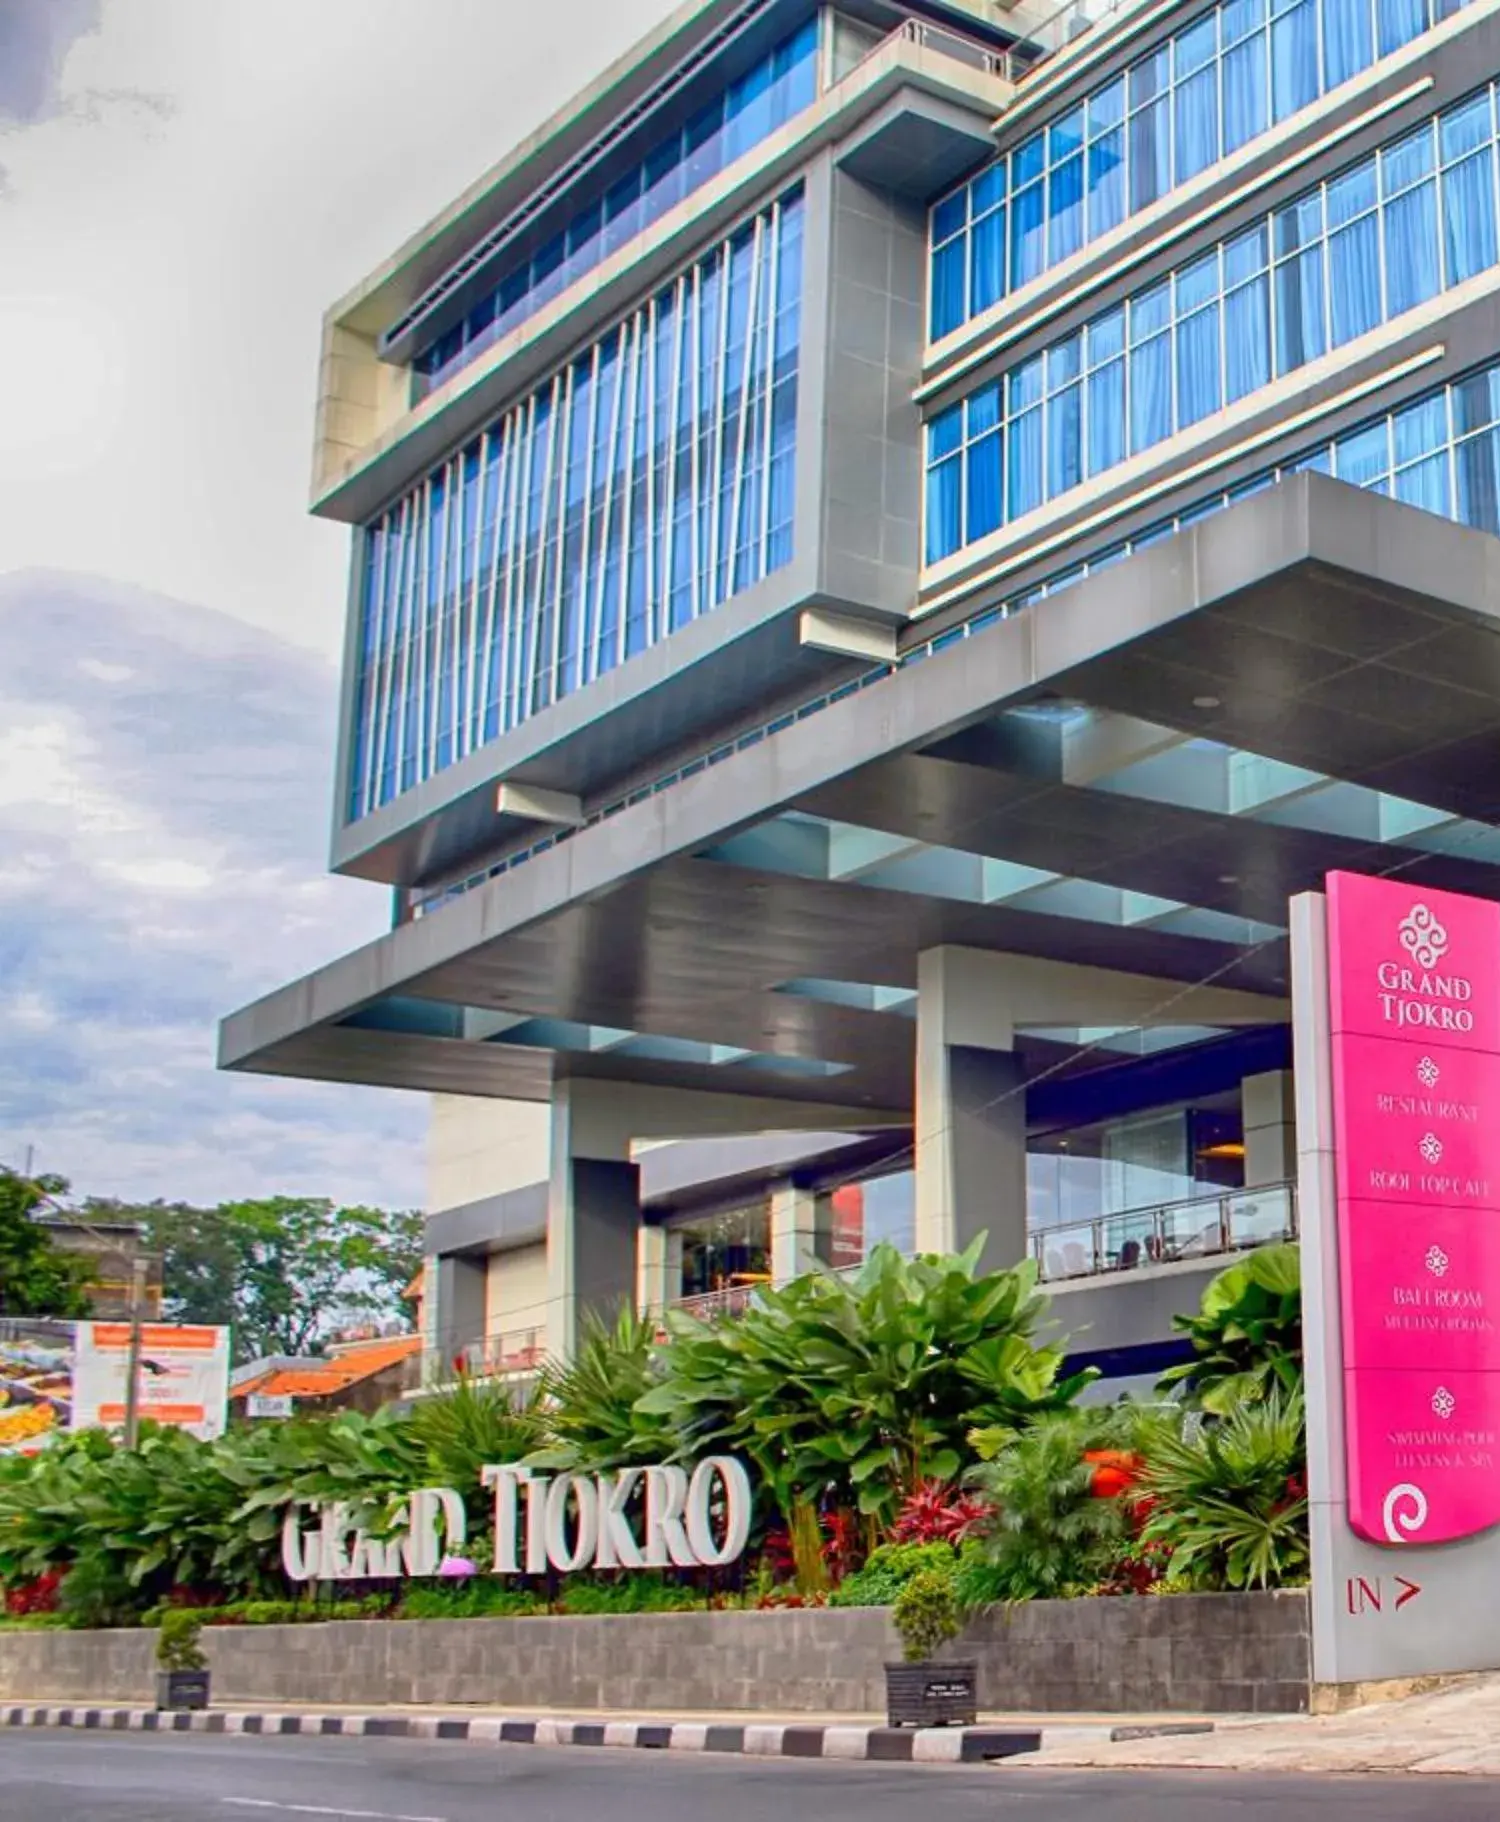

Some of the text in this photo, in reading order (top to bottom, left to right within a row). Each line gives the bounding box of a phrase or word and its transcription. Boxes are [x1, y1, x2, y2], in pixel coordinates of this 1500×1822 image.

[1377, 961, 1472, 1001] GRAND
[1377, 992, 1474, 1032] TJOKRO
[1376, 1092, 1480, 1121] RESTAURANT
[1346, 1576, 1382, 1615] IN
